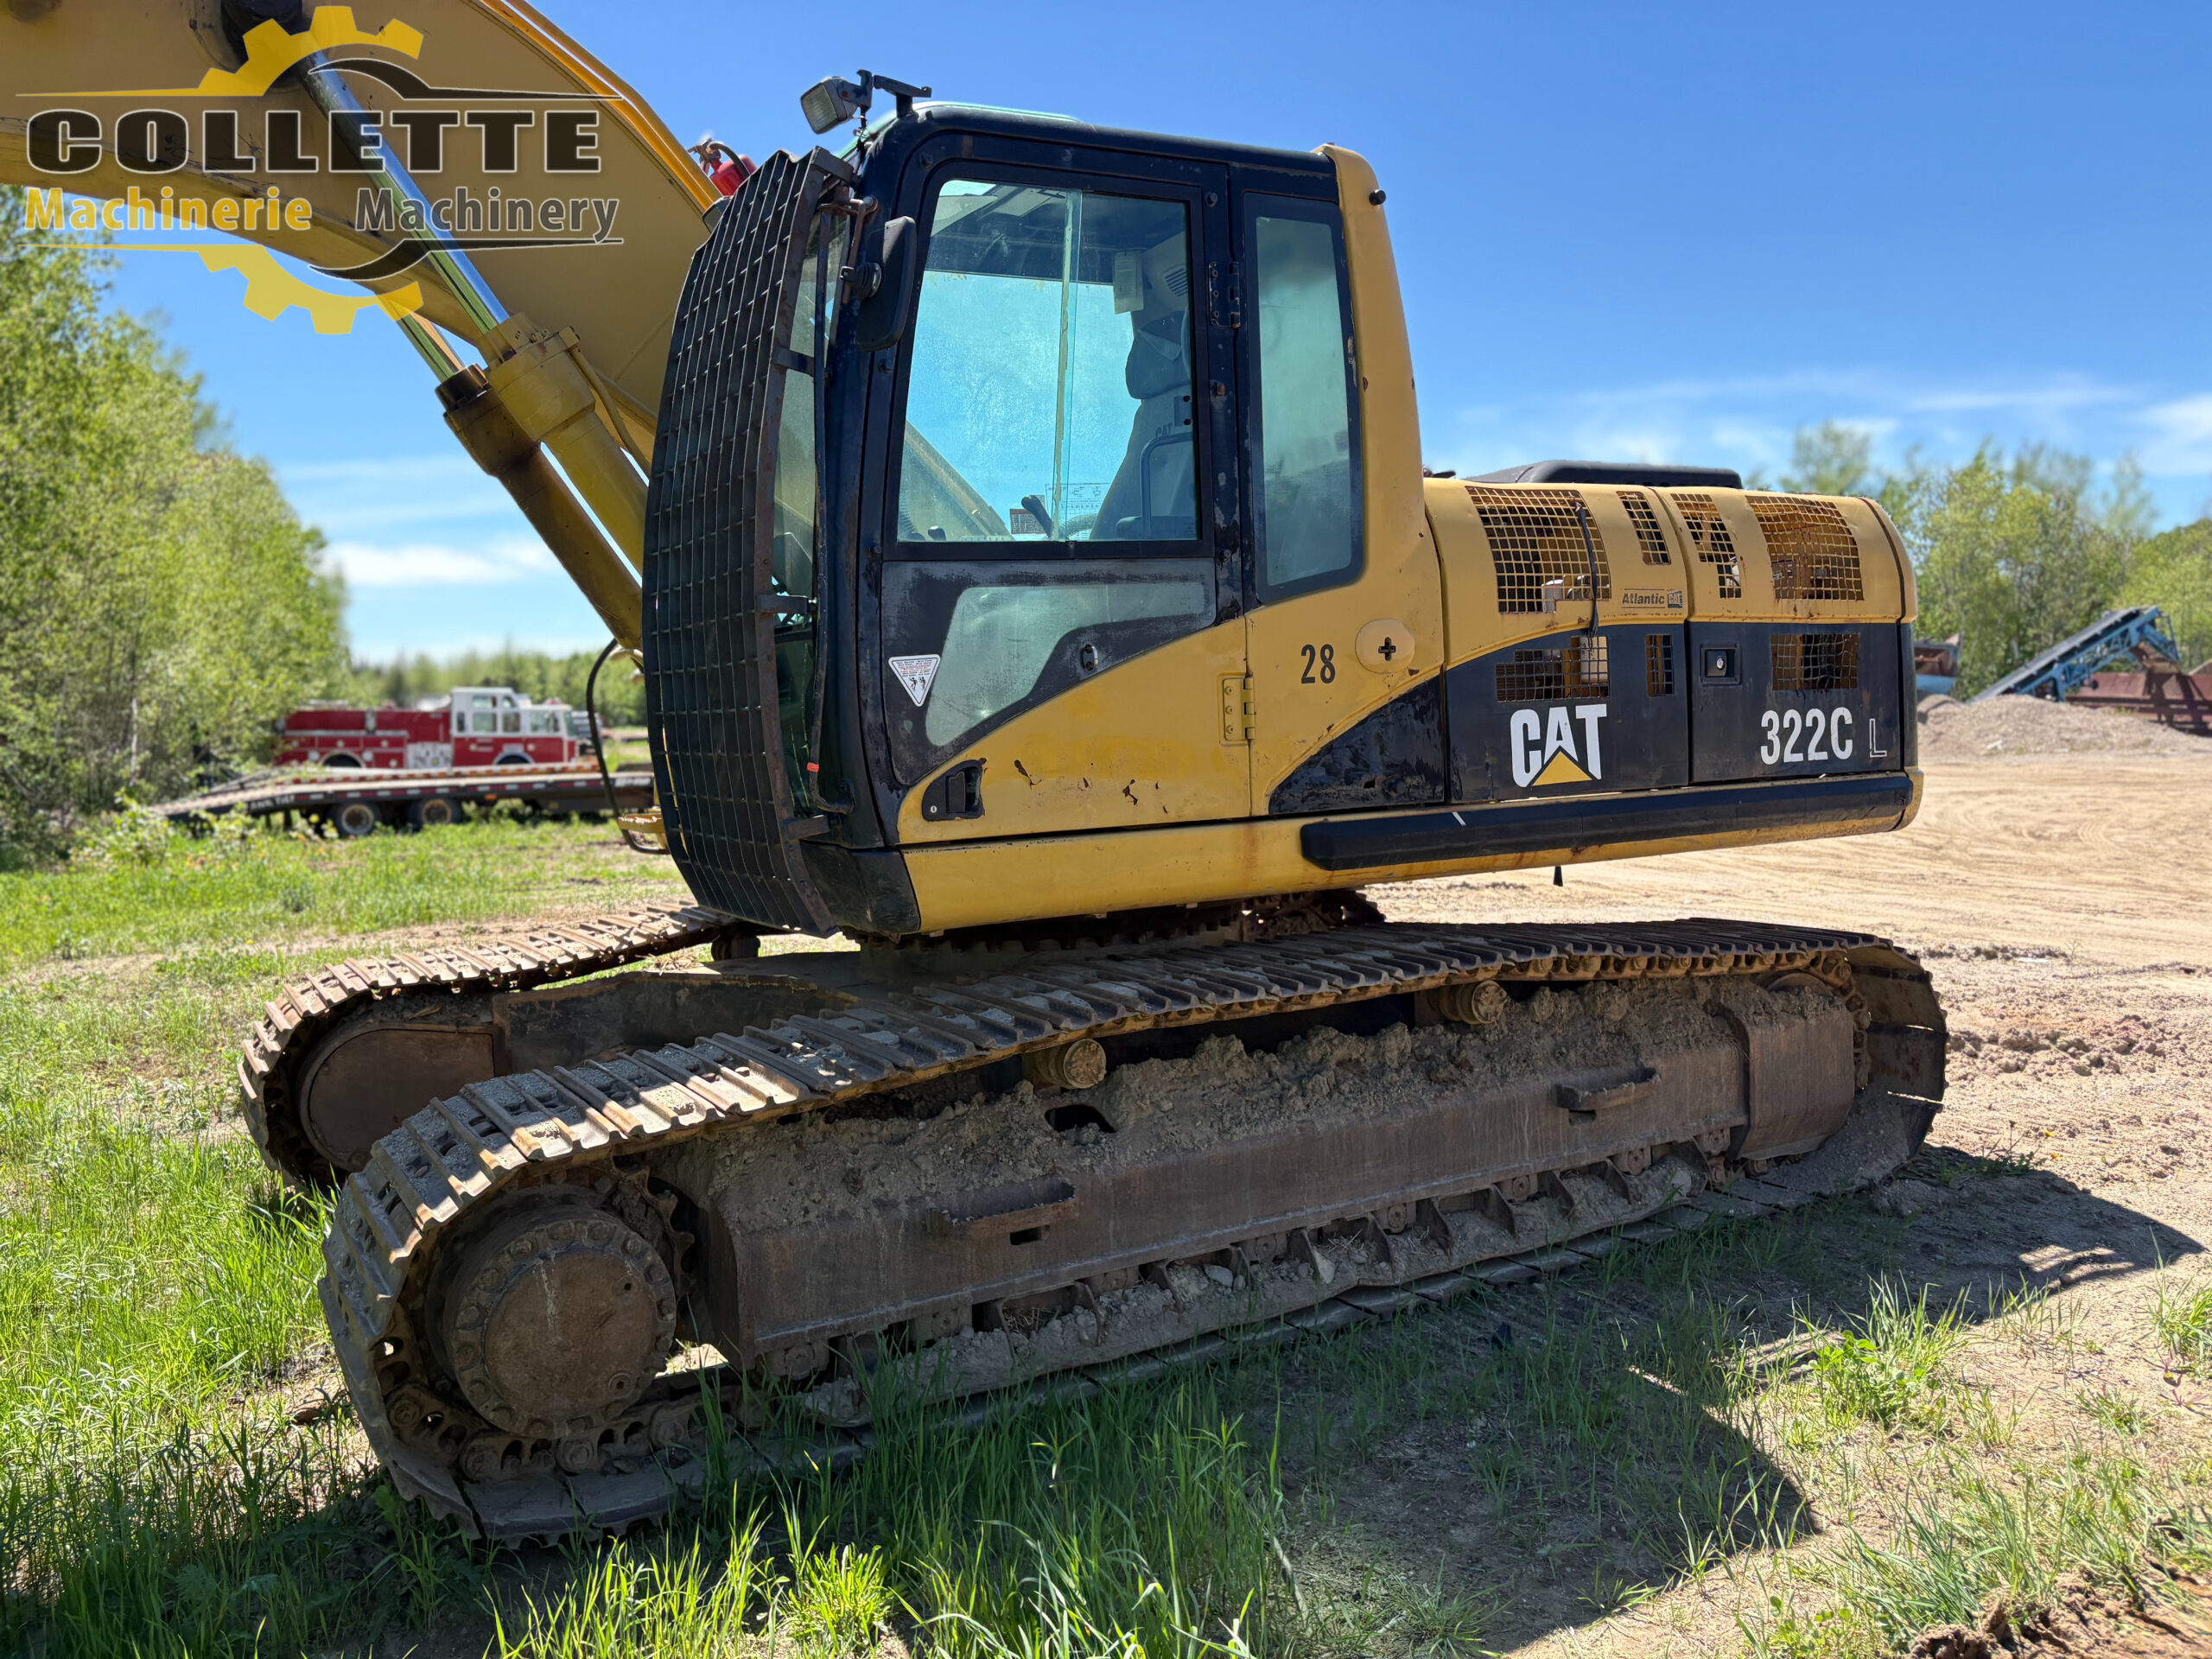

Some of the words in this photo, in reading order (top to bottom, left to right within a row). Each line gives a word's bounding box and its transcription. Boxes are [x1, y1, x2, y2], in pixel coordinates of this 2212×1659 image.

[1622, 593, 1665, 605] Atlantic
[1300, 644, 1336, 684] 28
[1510, 703, 1607, 788] CAT
[1760, 707, 1853, 765] 322C
[1869, 718, 1887, 758] L
